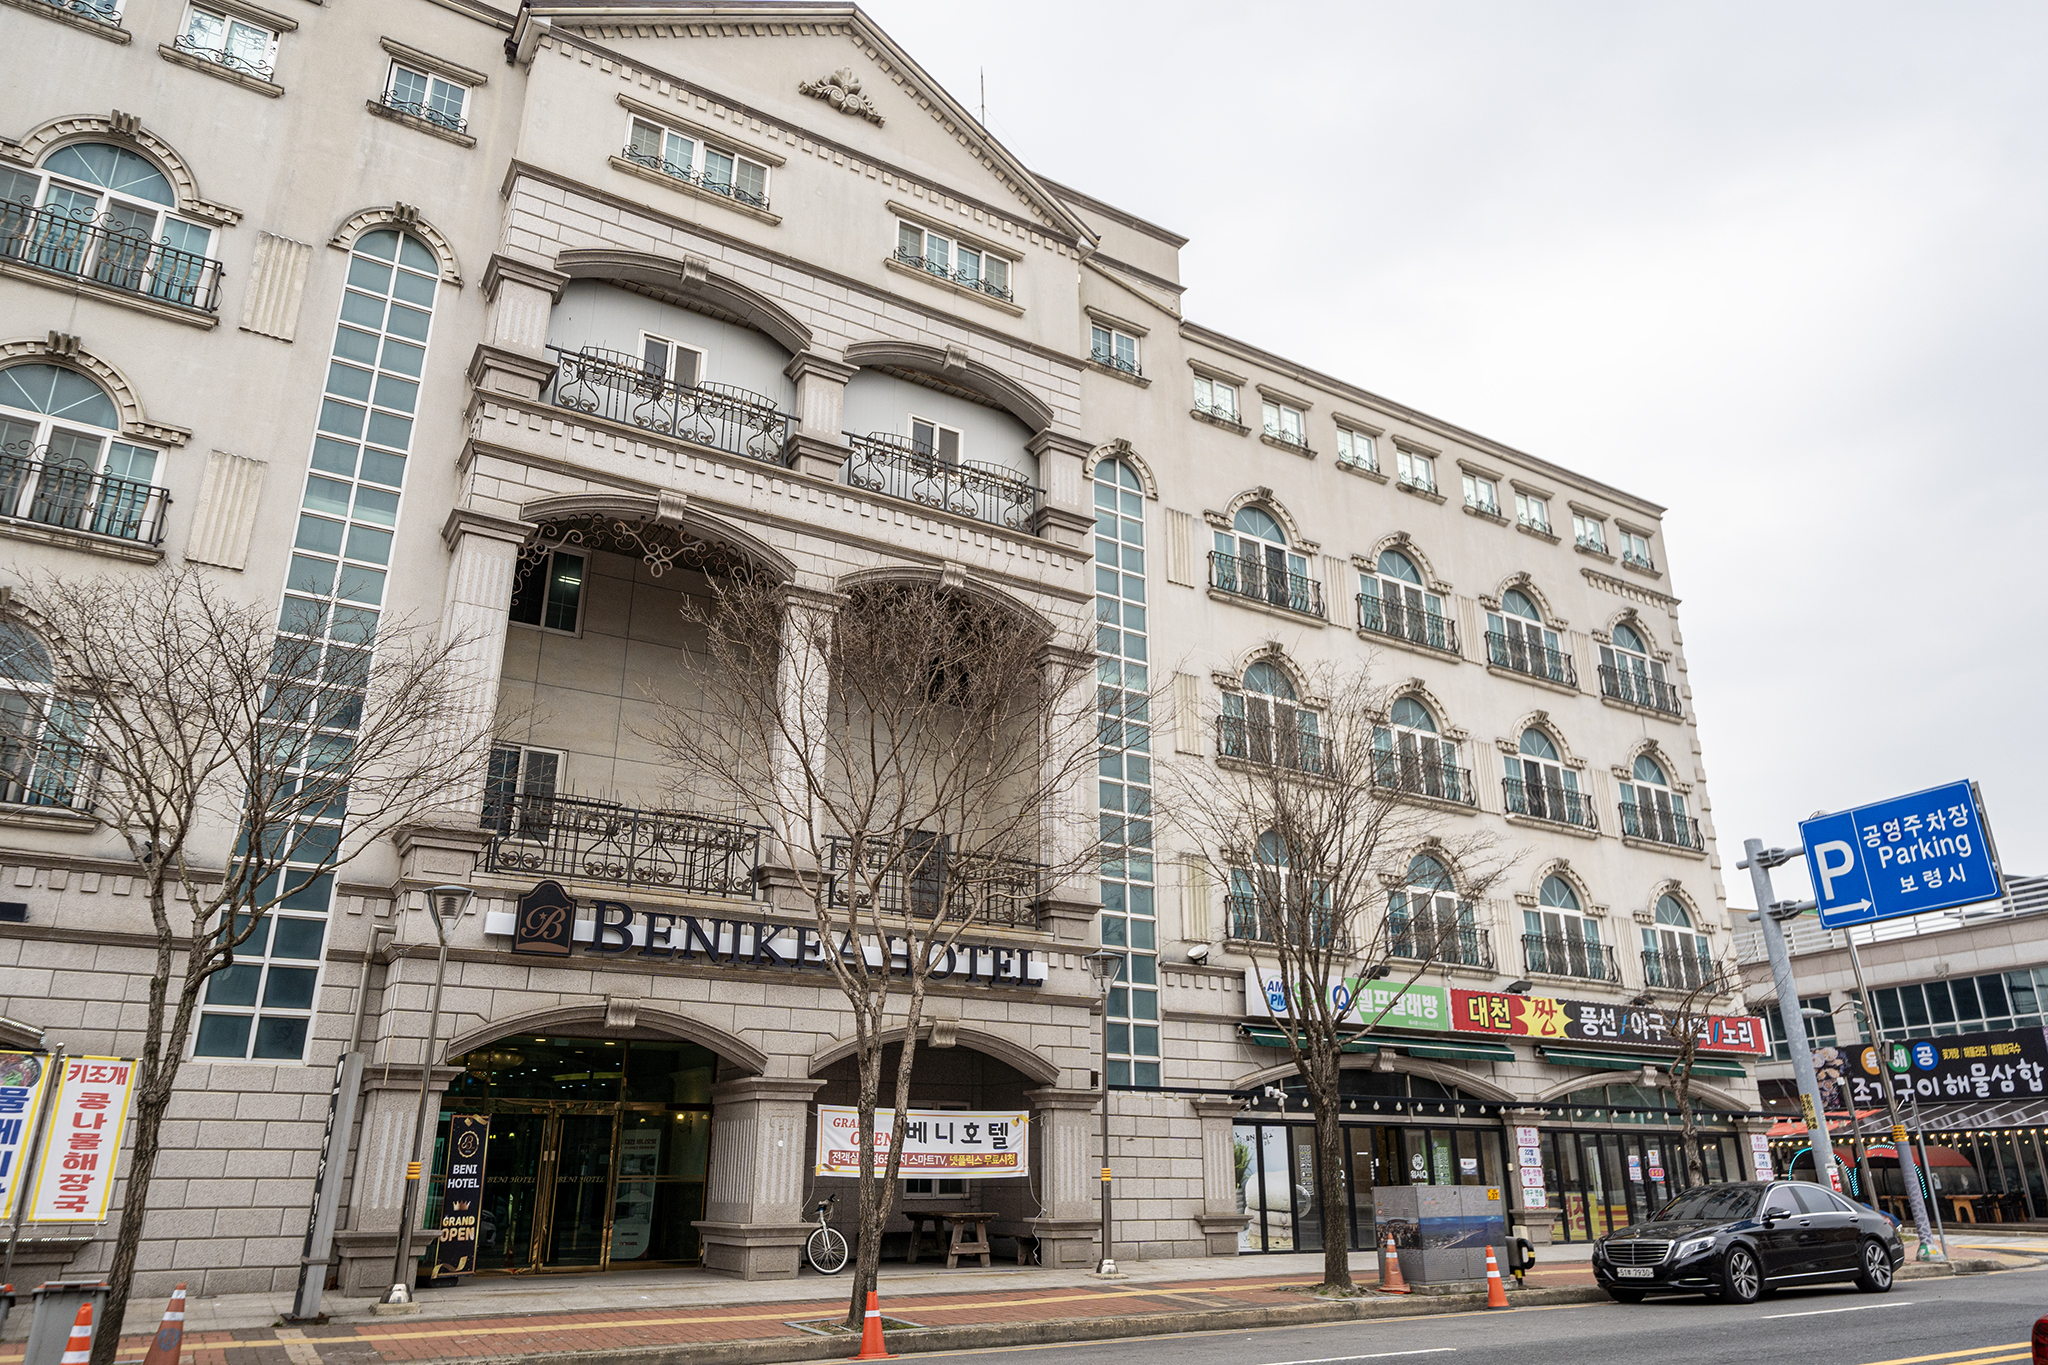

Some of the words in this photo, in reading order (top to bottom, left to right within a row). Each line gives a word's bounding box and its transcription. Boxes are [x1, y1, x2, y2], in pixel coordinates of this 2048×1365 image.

[1862, 803, 1969, 848] 공영주차장
[1878, 833, 1972, 869] Parking
[1814, 839, 1855, 901] P
[1900, 863, 1967, 894] 보령시
[585, 899, 874, 975] BENIKEA
[880, 933, 1044, 987] HOTEL
[1468, 996, 1512, 1029] 대천
[1579, 1005, 1618, 1037] 풍선
[1722, 1019, 1756, 1049] 노리
[67, 1063, 129, 1086] 키조개
[851, 1131, 893, 1147] OEN
[905, 1121, 1010, 1150] 베니호텔
[53, 1092, 112, 1213] 콩나물해장국
[447, 1178, 480, 1189] HOTEL
[453, 1164, 478, 1175] BENI
[440, 1227, 475, 1242] OPEN
[443, 1216, 475, 1227] GRAND
